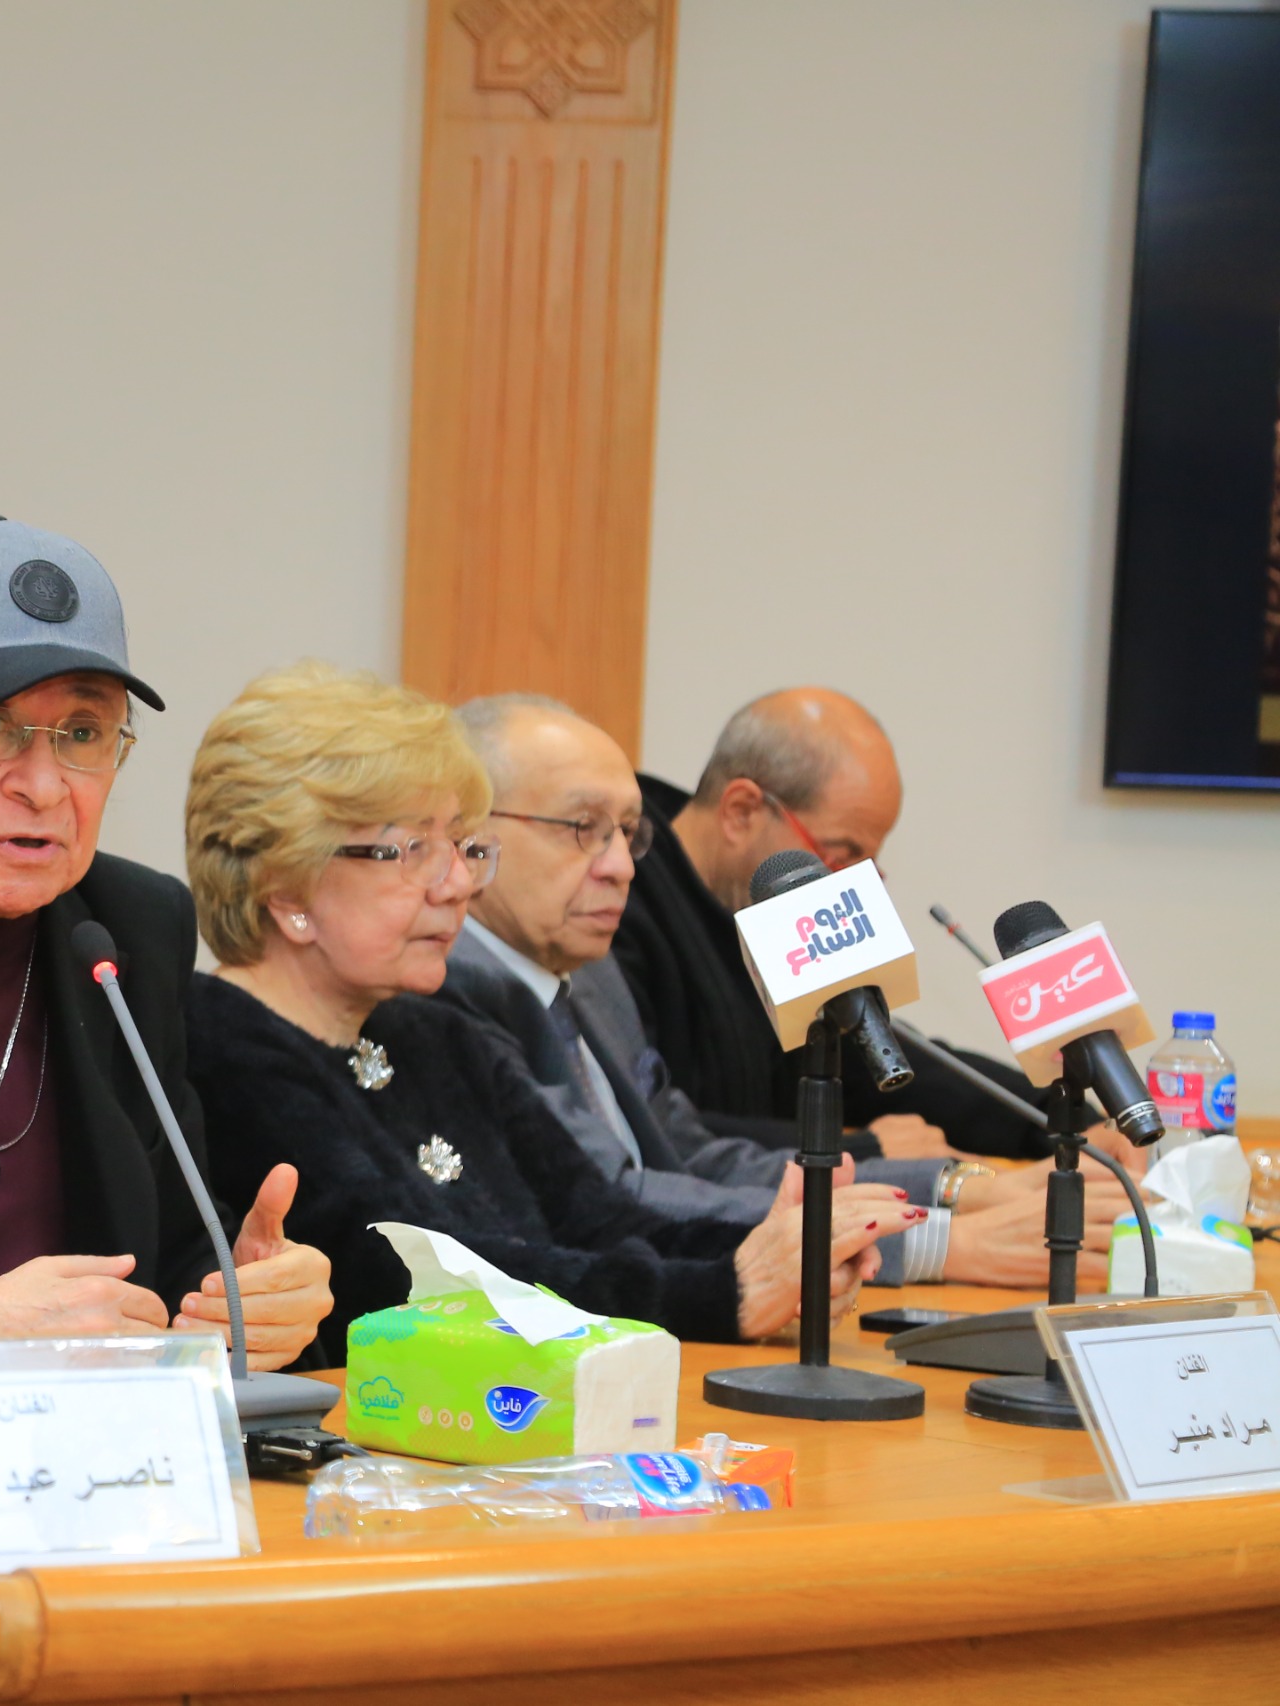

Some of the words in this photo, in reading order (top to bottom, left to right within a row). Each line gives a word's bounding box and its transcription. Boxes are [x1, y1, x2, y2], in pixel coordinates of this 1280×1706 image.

[795, 888, 864, 943] اليوم
[786, 913, 876, 976] السابع
[1010, 952, 1105, 1022] عين
[1176, 1353, 1210, 1380] الفنان
[491, 1390, 523, 1415] فاين
[1168, 1413, 1217, 1454] منير
[1221, 1411, 1272, 1446] مراد
[6, 1467, 55, 1503] عبد
[75, 1455, 175, 1501] ناصر
